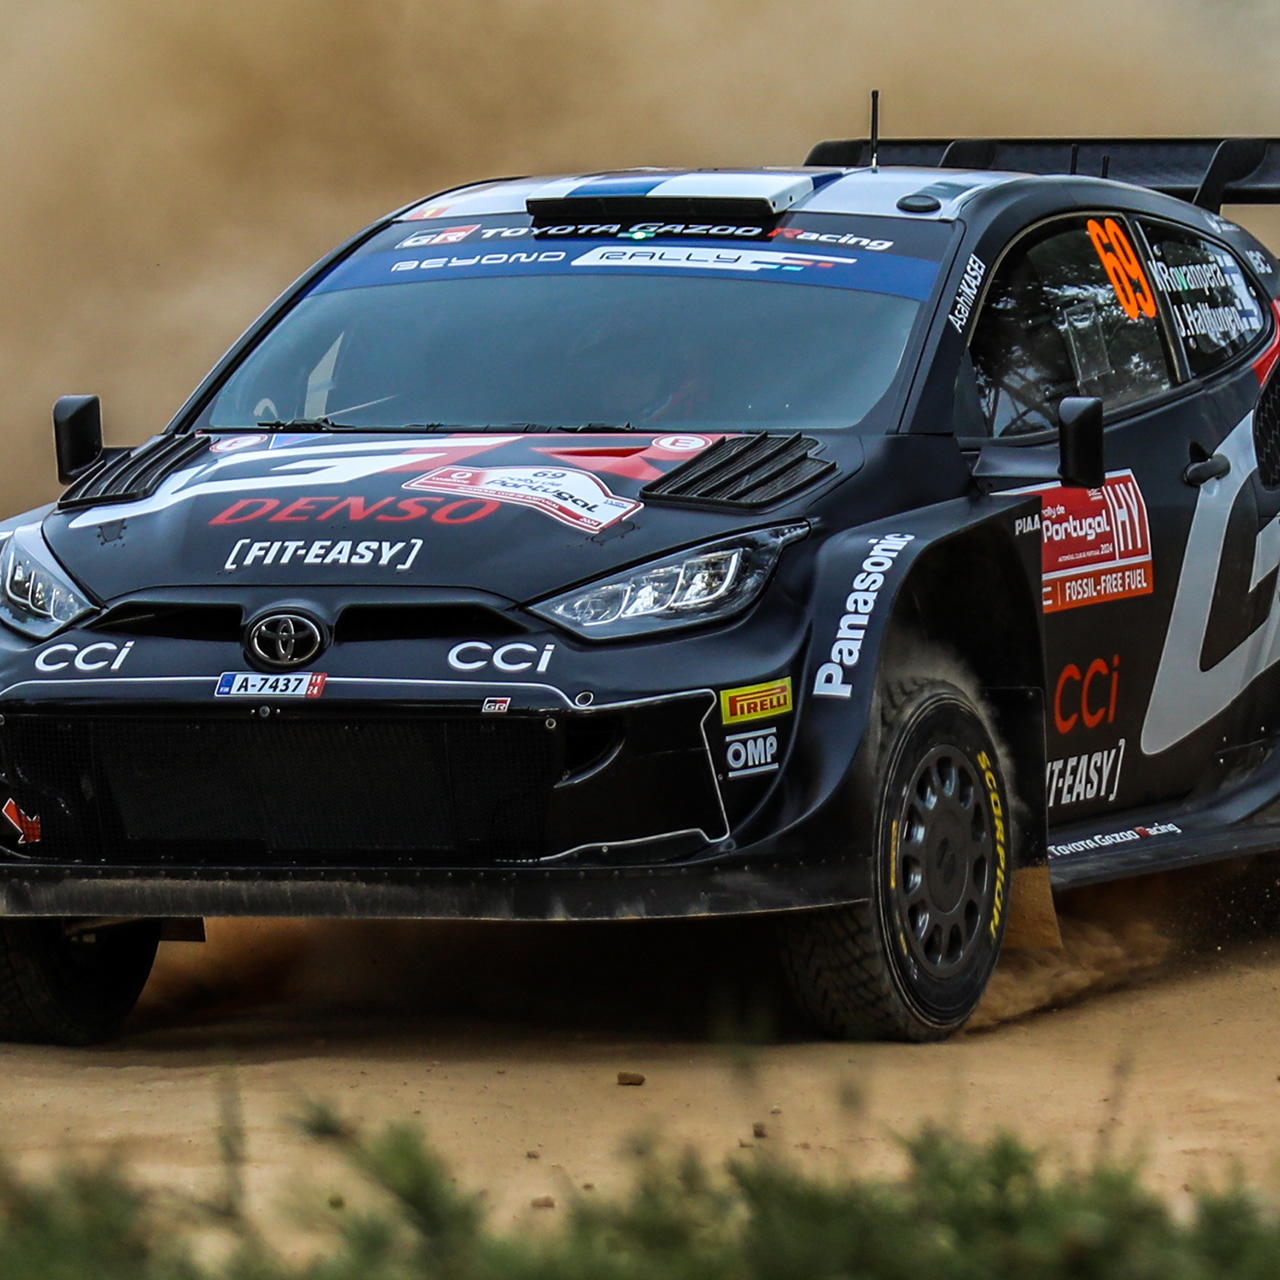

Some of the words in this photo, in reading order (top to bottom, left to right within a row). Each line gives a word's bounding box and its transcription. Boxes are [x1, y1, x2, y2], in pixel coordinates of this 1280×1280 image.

[481, 223, 622, 239] TOYOTA
[628, 222, 763, 237] GAZOO
[767, 226, 895, 252] Racing
[390, 251, 567, 272] BEYOND
[599, 251, 742, 264] RALLY
[1086, 217, 1157, 320] 69
[948, 253, 987, 334] AsahiKASEI
[668, 438, 696, 449] E
[531, 470, 568, 480] 69
[208, 496, 501, 526] DENSO
[485, 479, 600, 513] Portugal
[1015, 513, 1041, 536] PIAA
[1042, 509, 1111, 543] Portugal
[1115, 481, 1142, 552] HY
[1065, 572, 1124, 602] FOSSIL-FREE
[1125, 568, 1148, 591] FUEL
[813, 531, 916, 699] Panasonic
[236, 677, 303, 692] A-7437
[307, 686, 319, 695] 24
[483, 700, 509, 712] GR
[729, 684, 788, 718] PIRELLI
[726, 734, 778, 769] OMP
